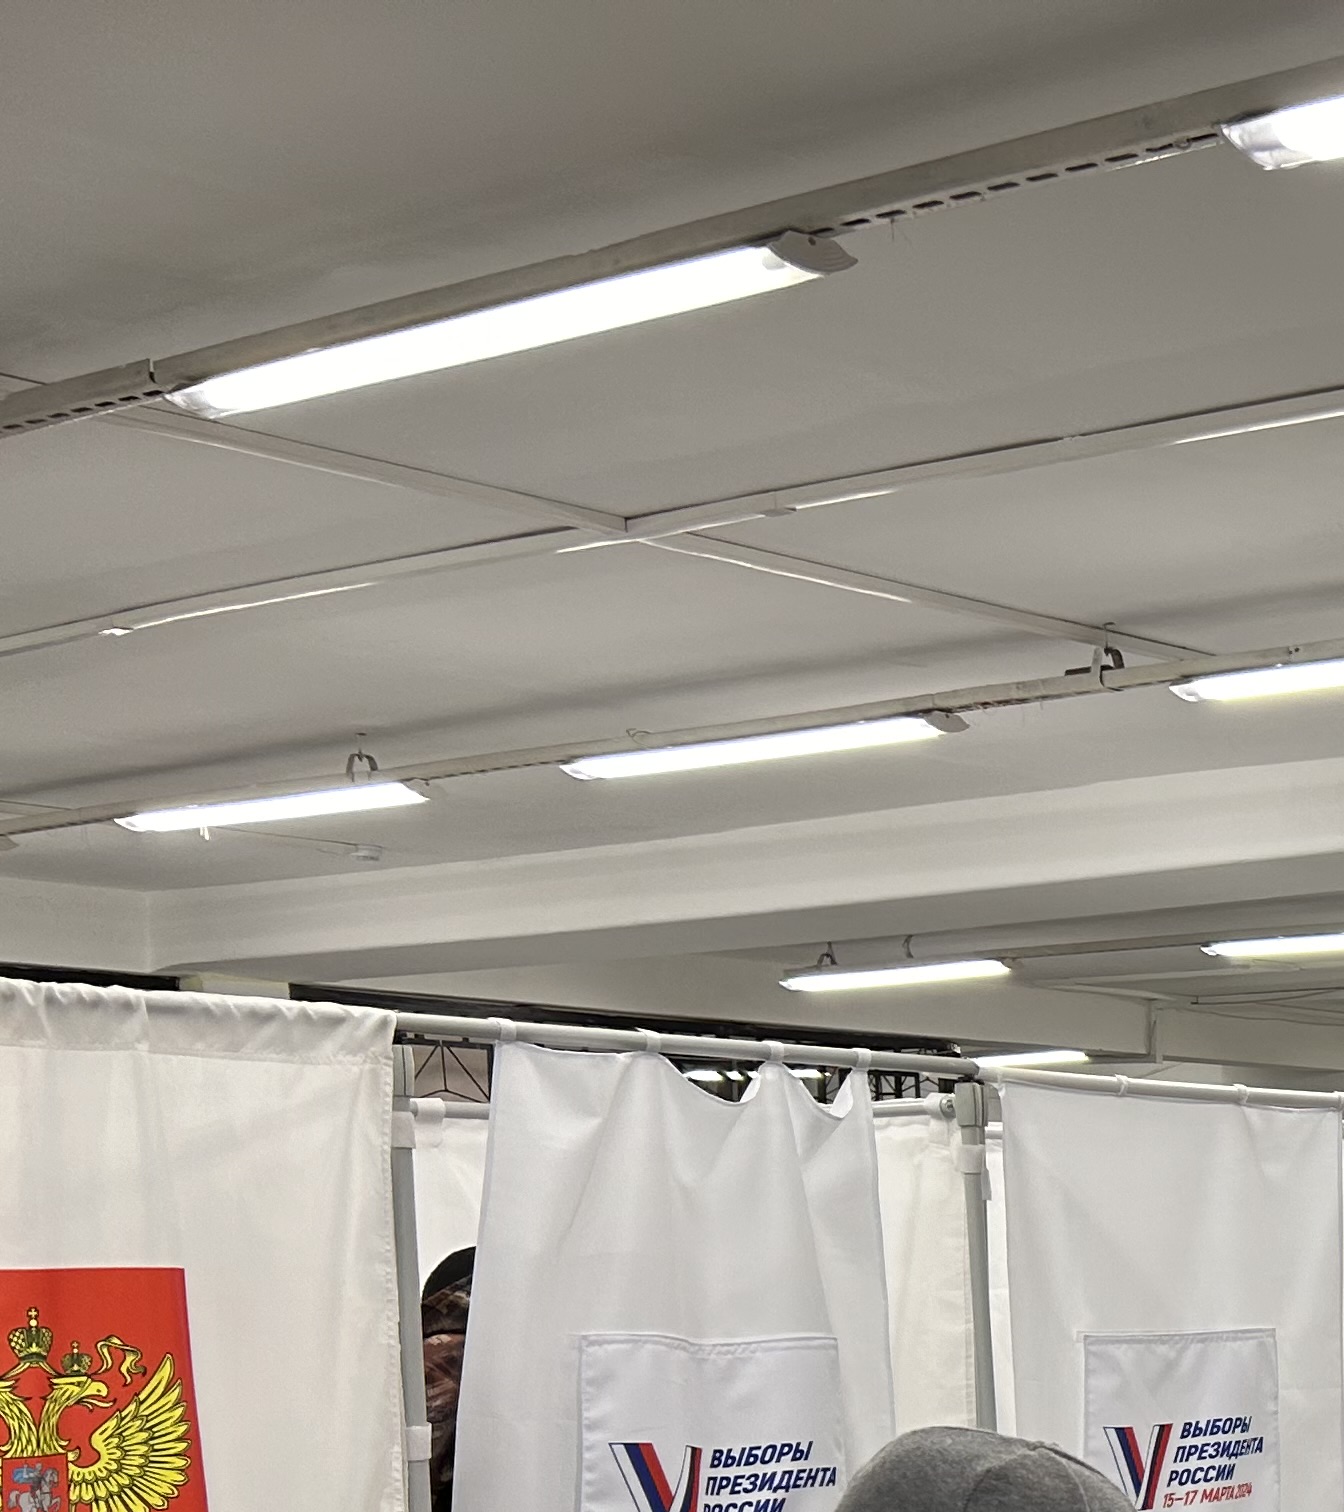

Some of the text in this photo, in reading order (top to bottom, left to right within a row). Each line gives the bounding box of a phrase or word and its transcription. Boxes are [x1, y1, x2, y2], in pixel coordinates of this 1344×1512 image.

[1179, 1416, 1252, 1439] ВЫБОРЫ
[709, 1441, 813, 1469] ВЫБОРЫ
[1173, 1437, 1264, 1463] ПРЕЗИДЕНТА
[705, 1467, 837, 1495] ПРЕЗИДЕНТА
[1166, 1463, 1236, 1487] РОССИИ
[1200, 1485, 1235, 1504] МАРТА
